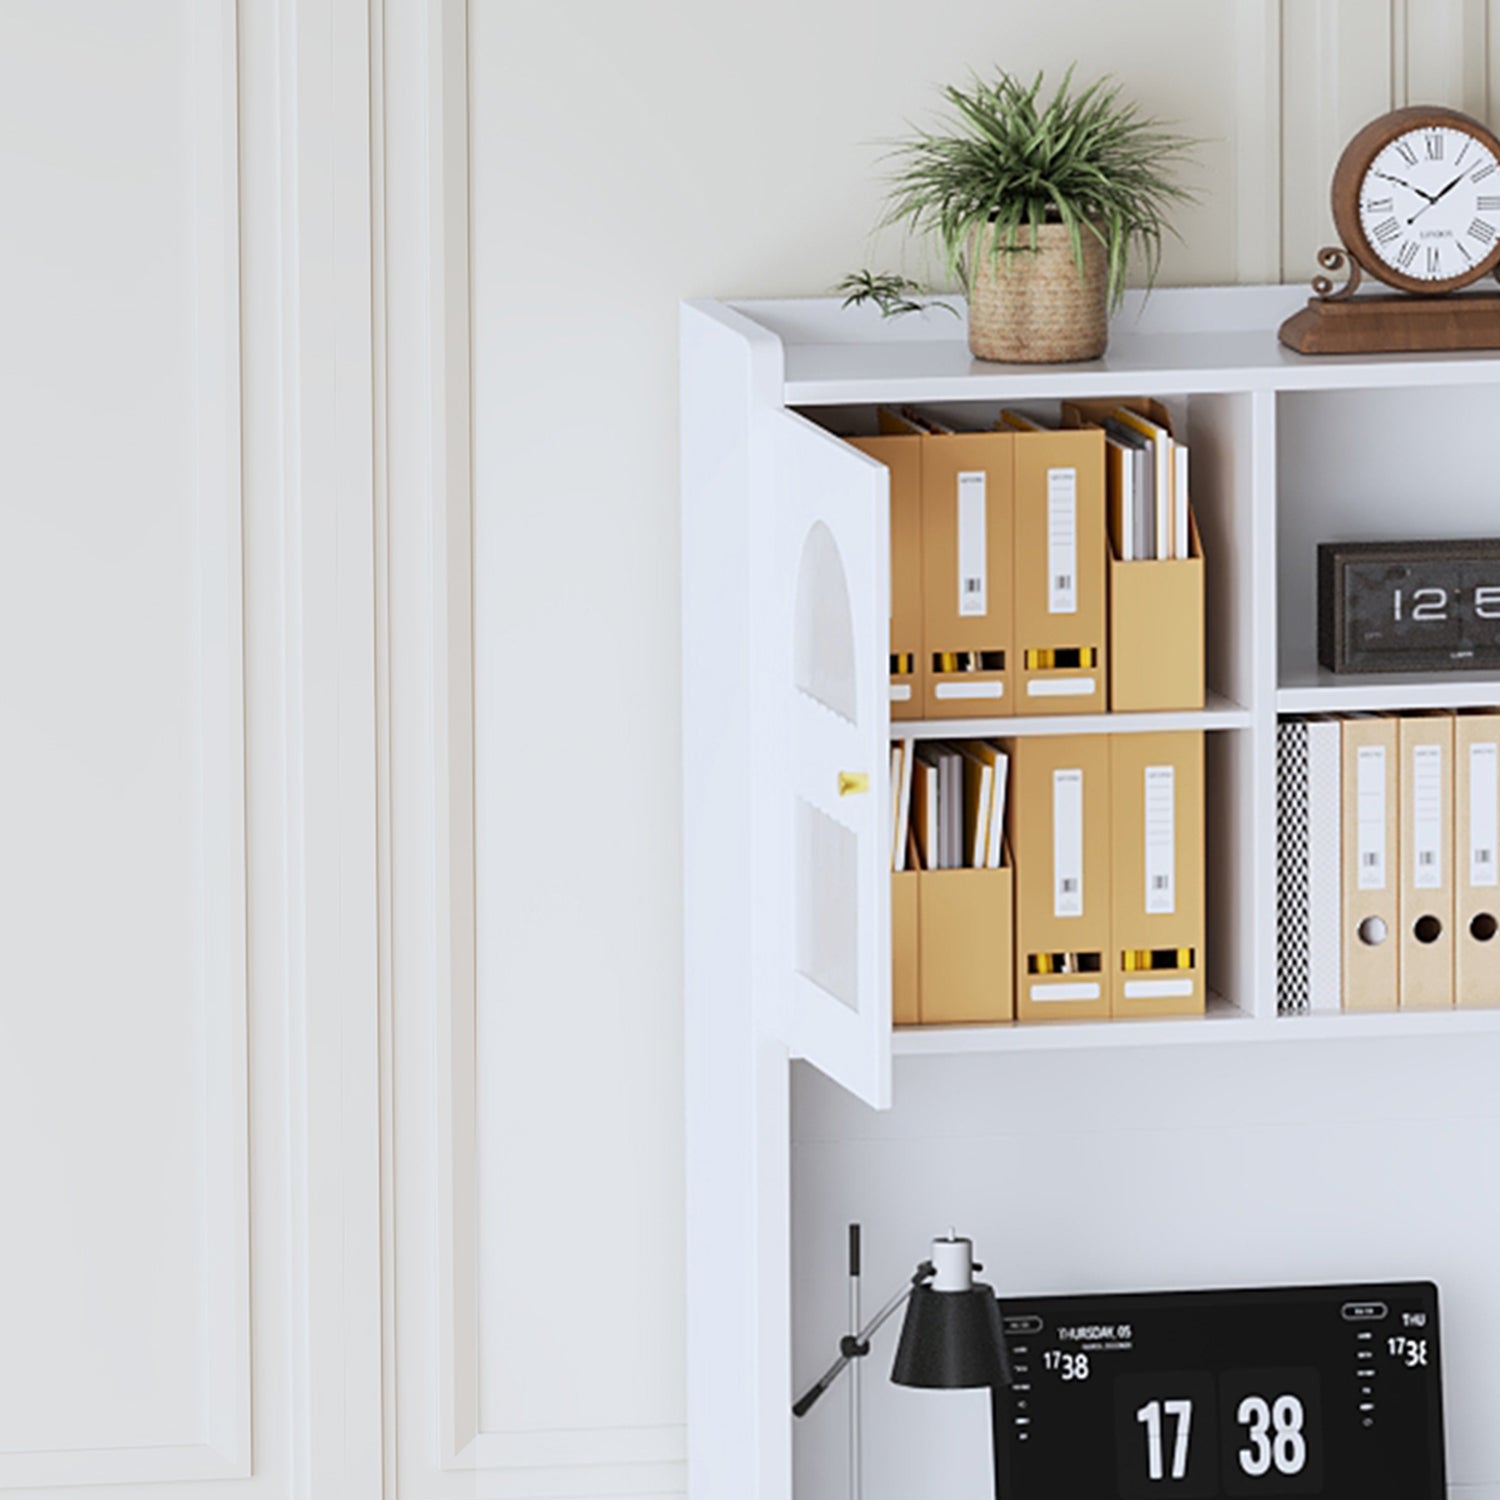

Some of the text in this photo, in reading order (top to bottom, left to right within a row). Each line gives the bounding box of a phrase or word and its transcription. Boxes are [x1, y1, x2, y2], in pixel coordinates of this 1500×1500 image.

[1424, 134, 1444, 160] XII
[1470, 163, 1495, 184] II
[1394, 588, 1448, 620] 12
[1137, 1395, 1306, 1479] 17 38
